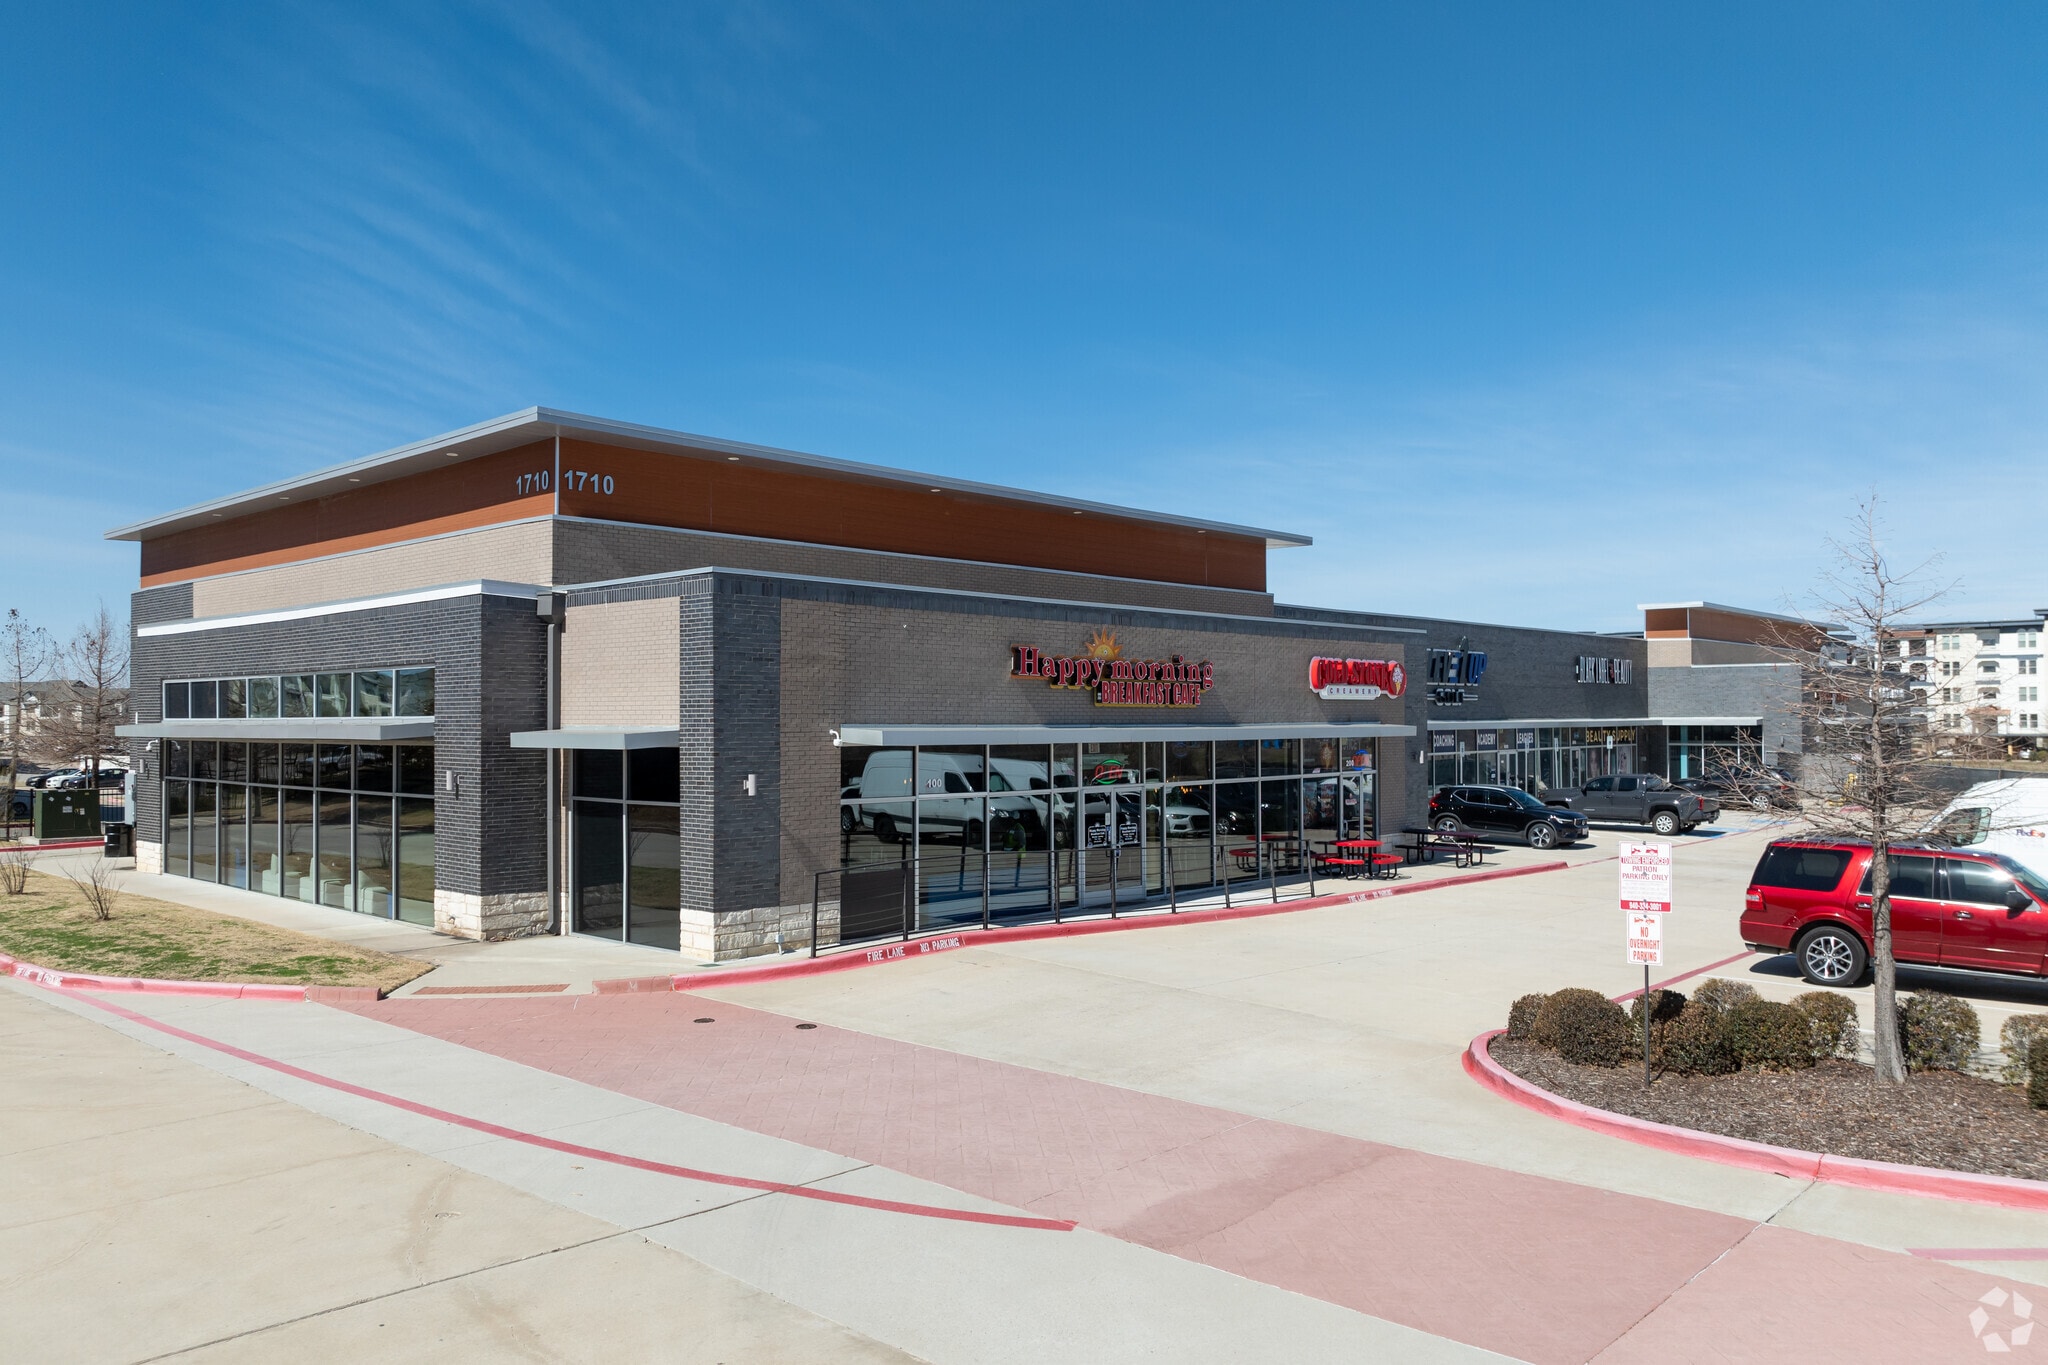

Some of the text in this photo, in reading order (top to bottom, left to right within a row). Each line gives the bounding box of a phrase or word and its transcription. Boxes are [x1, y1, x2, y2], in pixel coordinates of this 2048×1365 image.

[516, 470, 549, 495] 1710
[564, 469, 614, 495] 1710
[1018, 646, 1215, 690] Happy morning
[1468, 650, 1488, 686] UP
[1101, 681, 1201, 705] BREAKFAST CAFE
[1329, 687, 1378, 695] CREAMERY
[1433, 734, 1454, 747] COACHING
[1477, 733, 1496, 745] ACADEMY
[1612, 729, 1636, 742] SUPPLY
[927, 778, 942, 788] 100
[1632, 865, 1658, 873] PATRON
[1622, 873, 1669, 881] PARKING ONLY
[1640, 926, 1649, 937] NO
[866, 937, 960, 962] FIRE LANE NO PARKING
[1629, 938, 1660, 950] OVERNIGHT
[1633, 950, 1657, 962] PARKING
